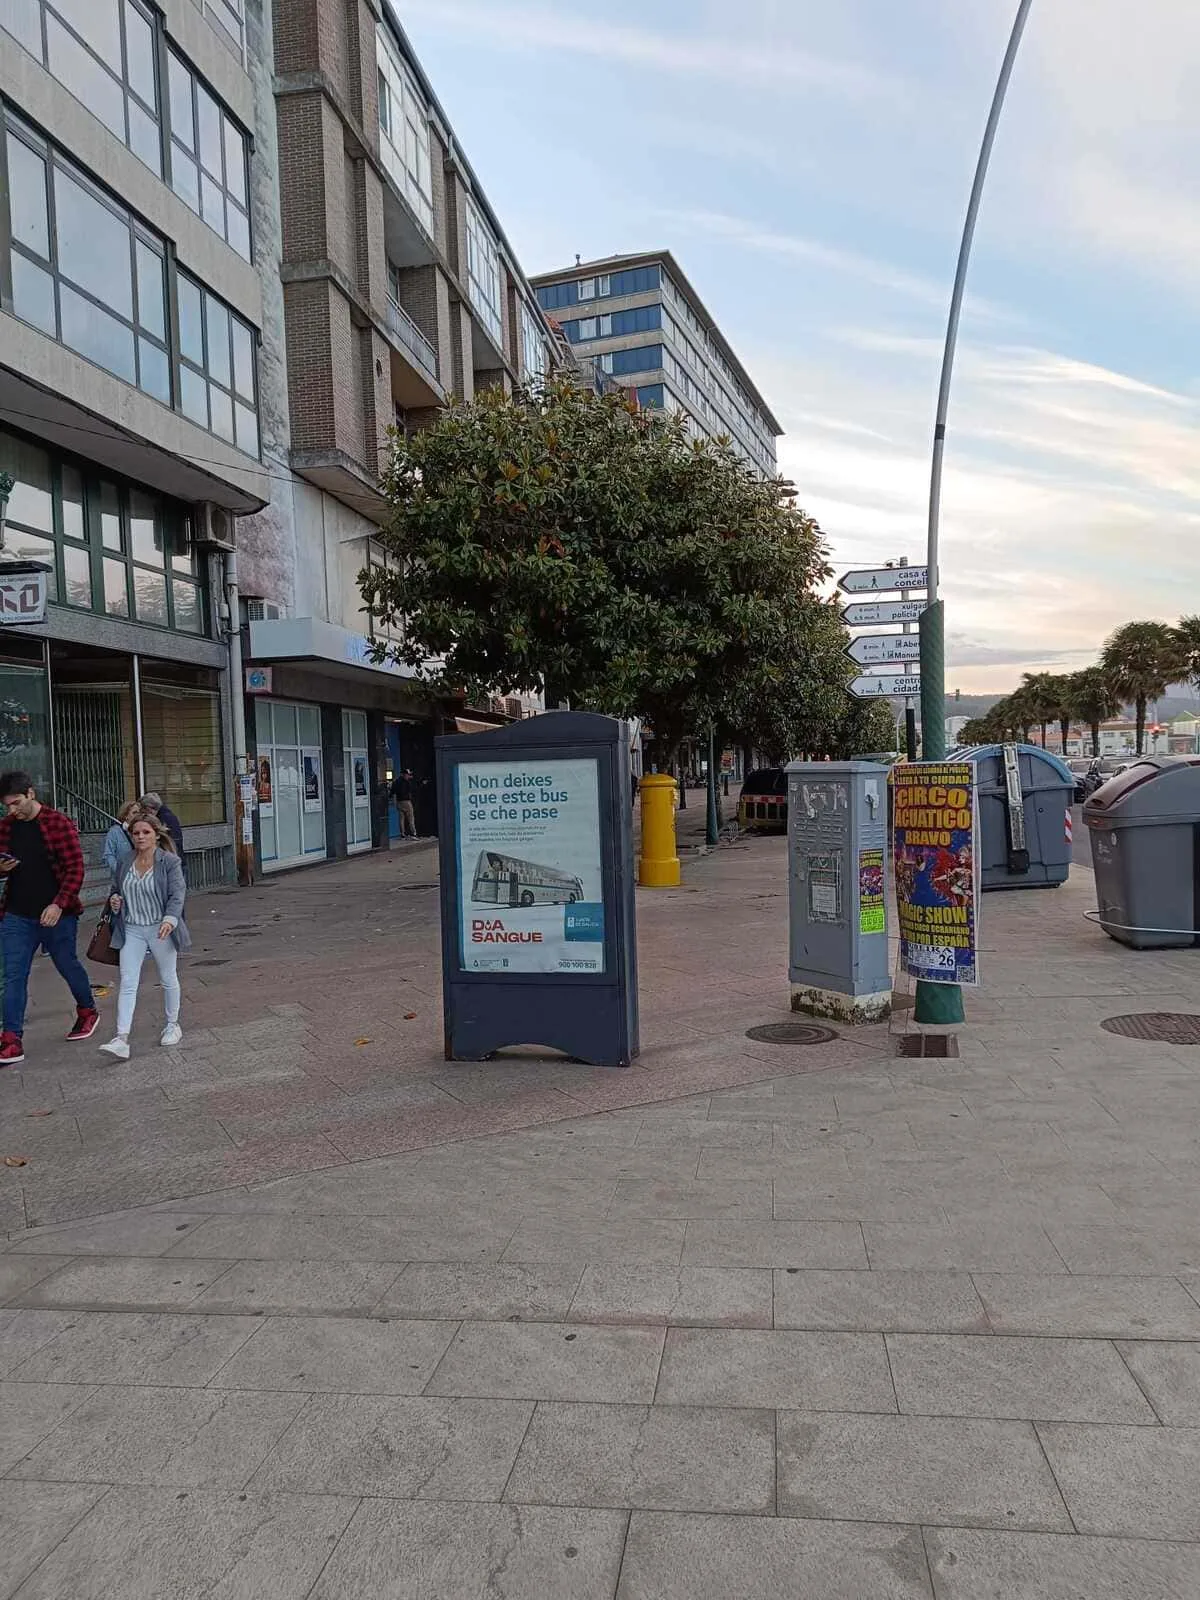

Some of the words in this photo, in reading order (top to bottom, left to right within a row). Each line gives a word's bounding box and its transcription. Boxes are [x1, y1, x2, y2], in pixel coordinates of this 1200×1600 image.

[898, 571, 919, 579] casa
[894, 577, 929, 587] concell
[901, 602, 927, 612] xulgad
[894, 651, 920, 659] Monum
[468, 775, 499, 788] Non
[503, 773, 553, 788] deixes
[931, 775, 970, 784] CIUDAD
[468, 792, 497, 808] que
[501, 790, 536, 803] este
[540, 788, 568, 802] bus
[897, 786, 968, 808] CIRCO
[469, 809, 486, 820] se
[490, 805, 518, 820] che
[522, 807, 558, 823] pase
[895, 808, 971, 829] ACUATICO
[905, 830, 951, 846] BRAVO
[925, 906, 967, 924] SHOW
[472, 932, 543, 943] SANGUE
[933, 934, 970, 947] ESPAÑA
[938, 954, 954, 967] 26
